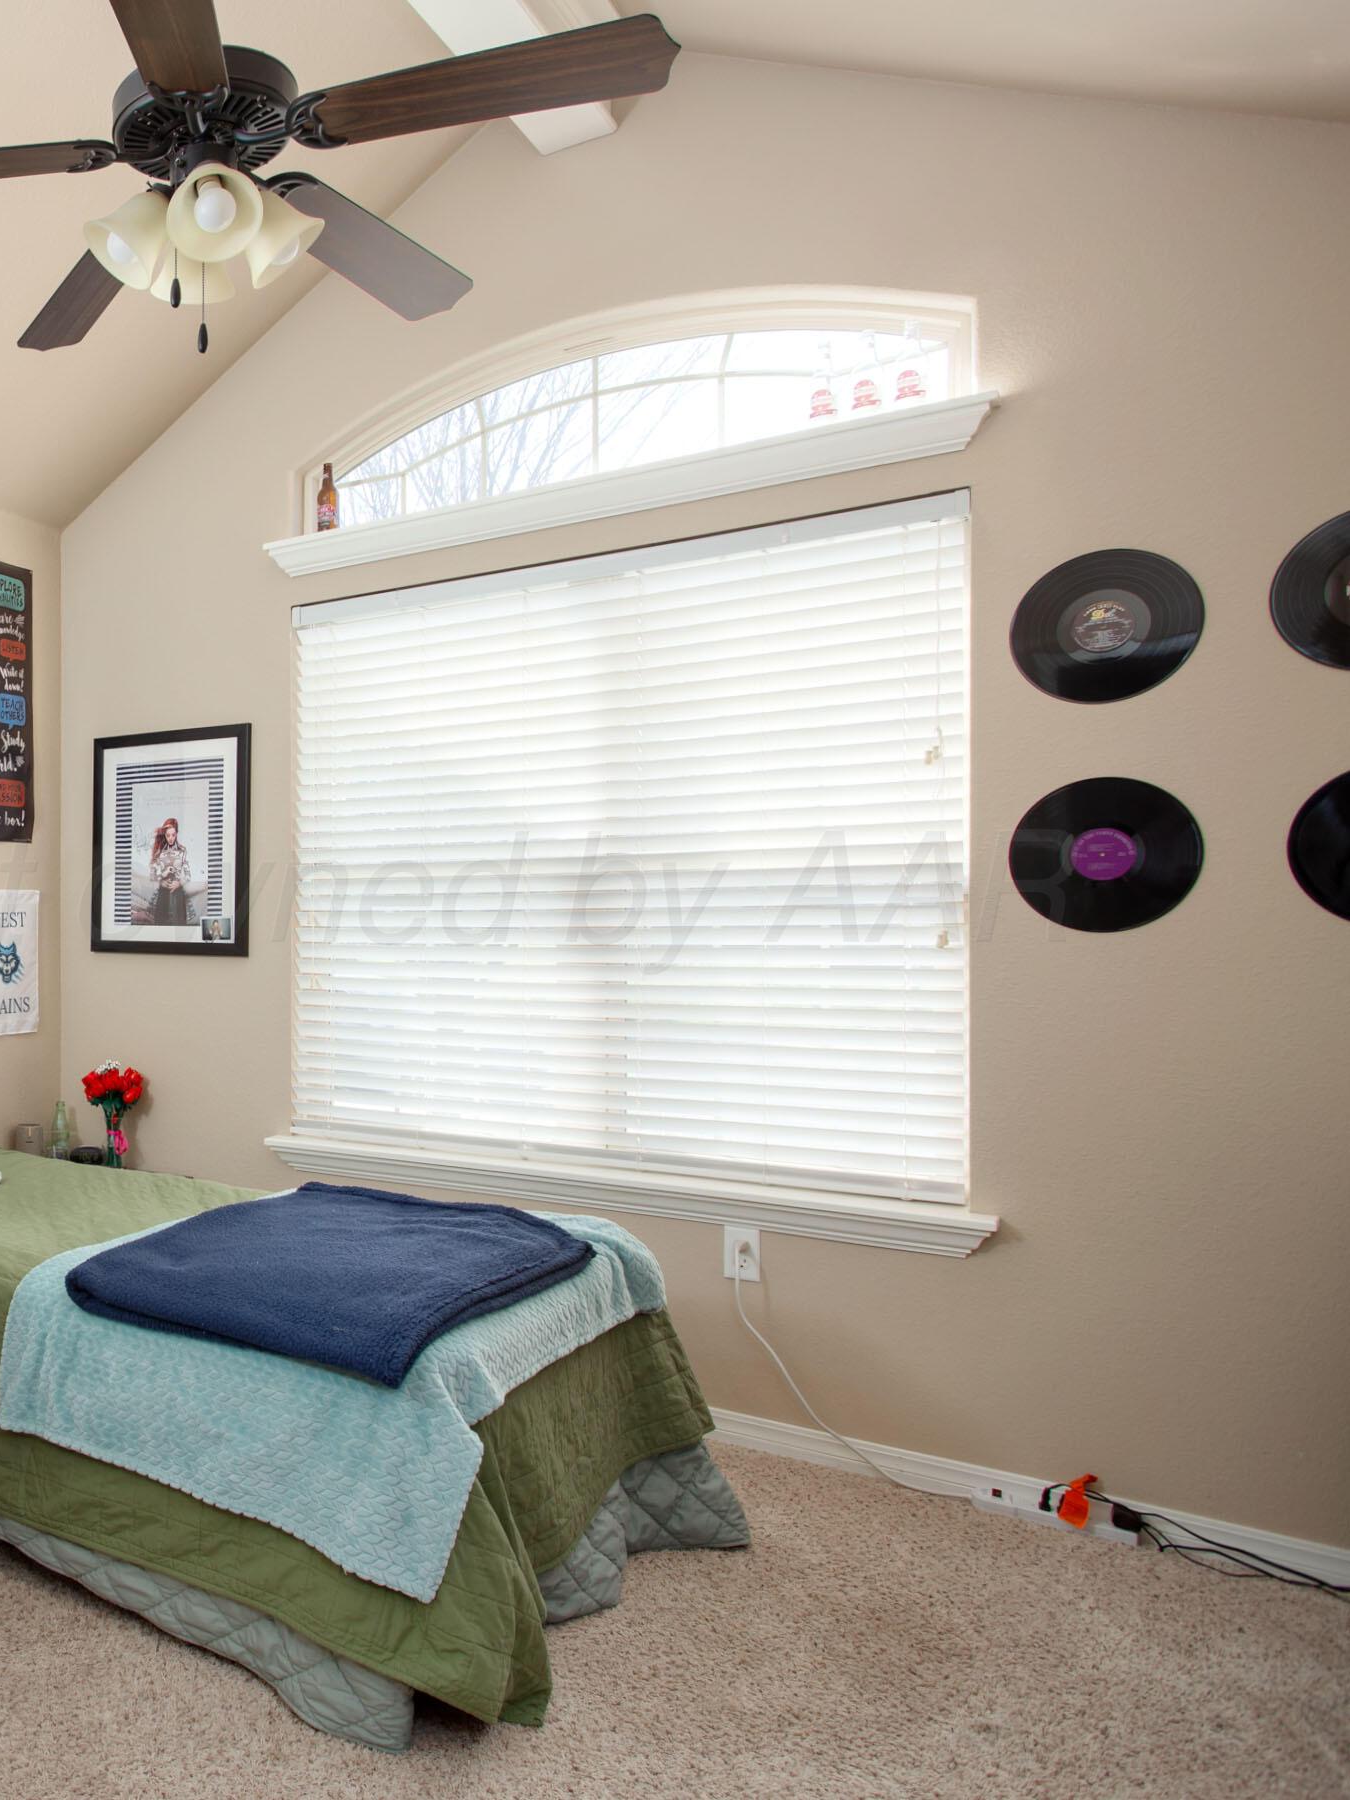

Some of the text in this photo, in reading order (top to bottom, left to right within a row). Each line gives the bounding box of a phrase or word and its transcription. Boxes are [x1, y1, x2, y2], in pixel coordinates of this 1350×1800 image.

[0, 708, 25, 723] OTHERS
[0, 729, 26, 754] Study
[4, 809, 26, 828] box!
